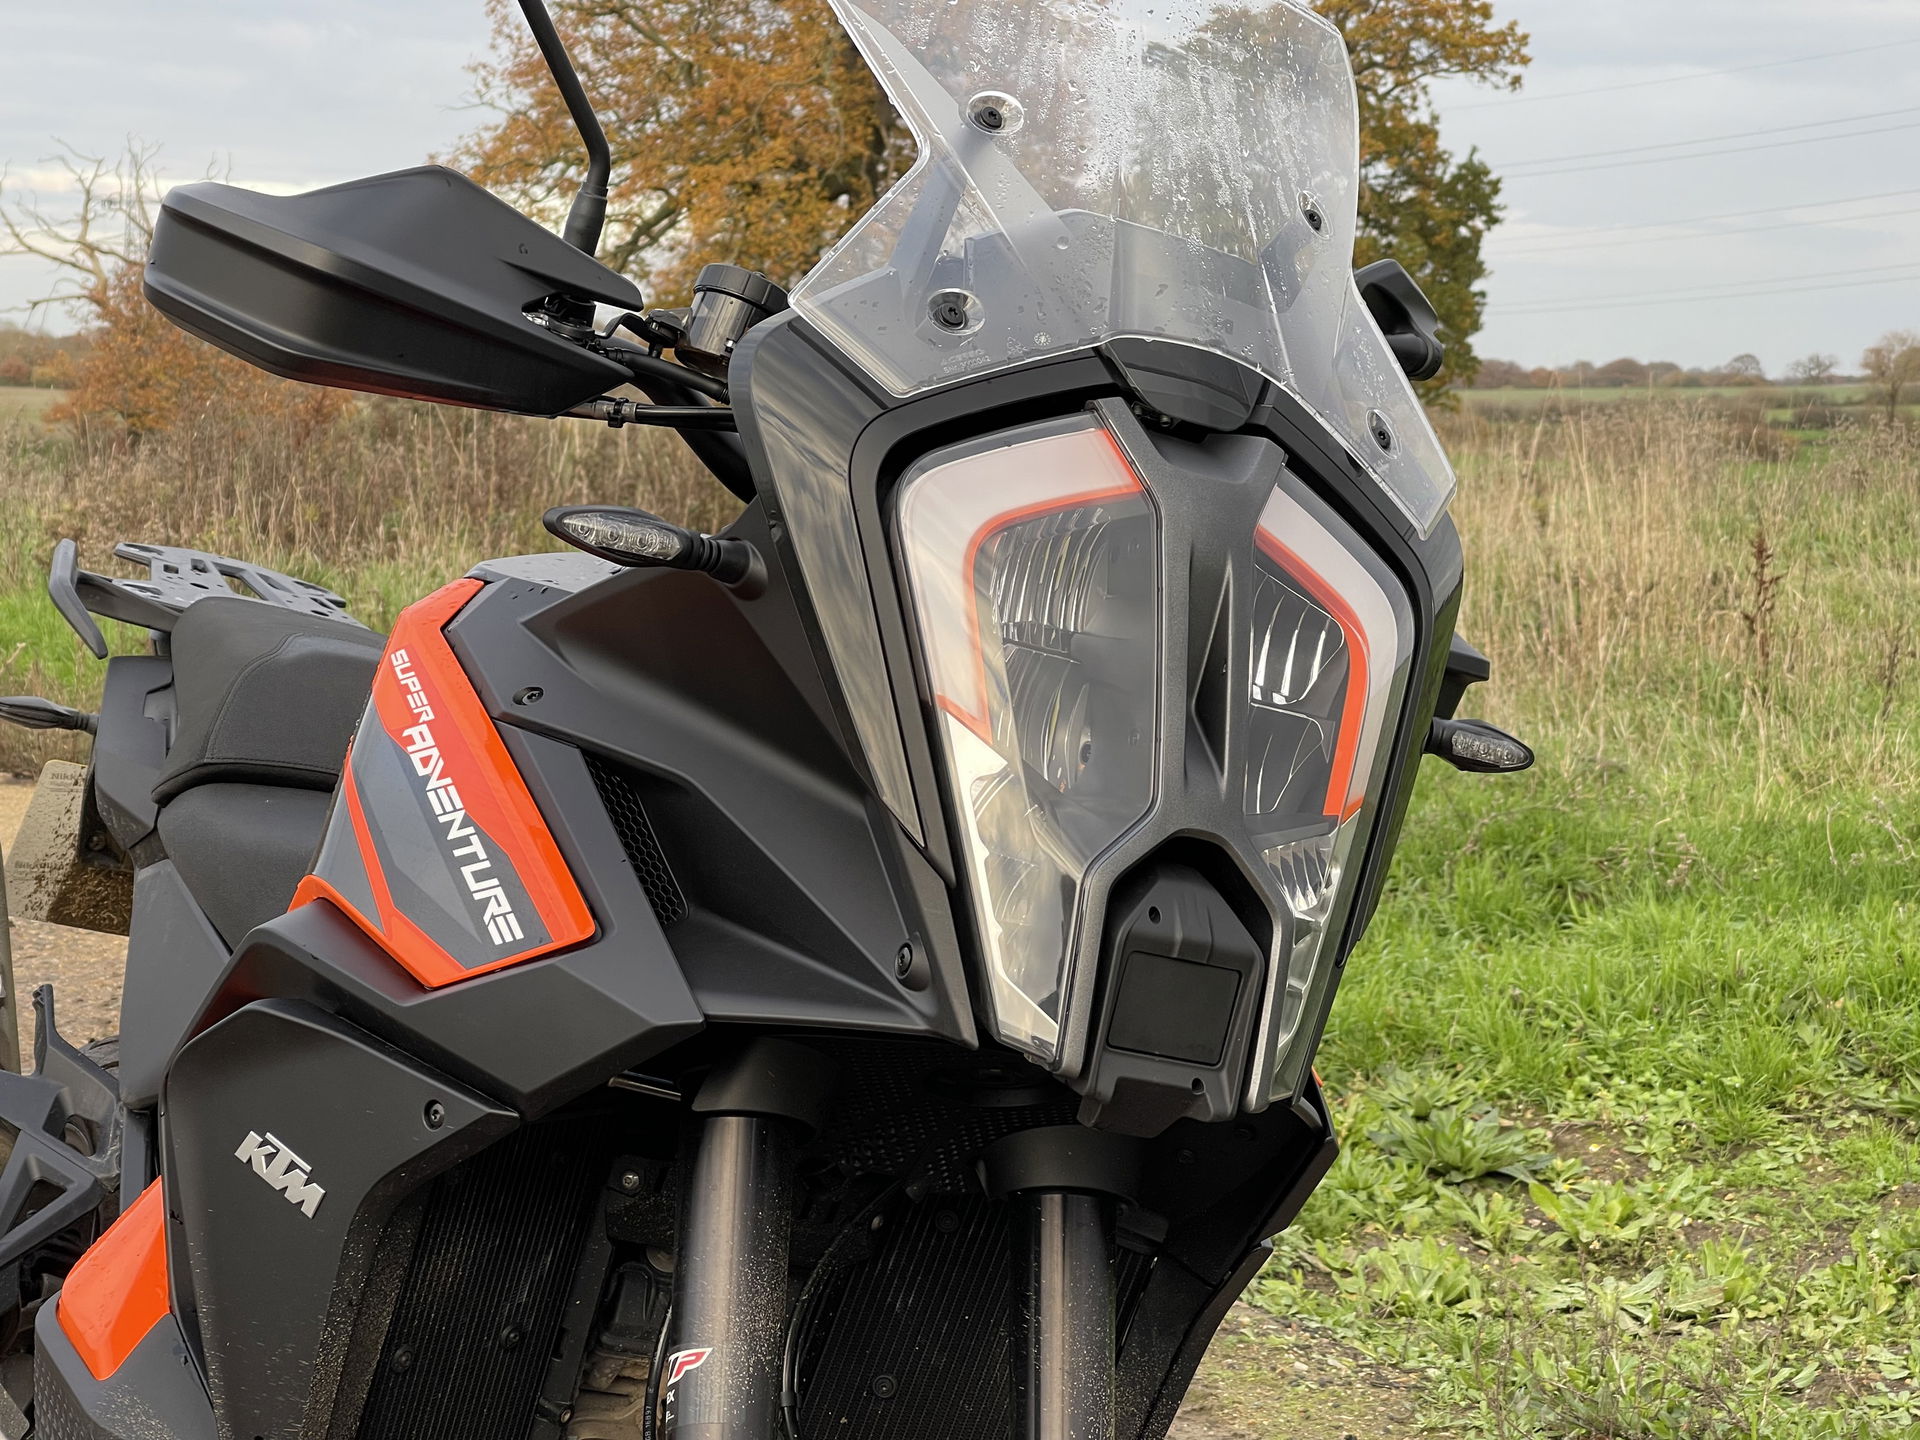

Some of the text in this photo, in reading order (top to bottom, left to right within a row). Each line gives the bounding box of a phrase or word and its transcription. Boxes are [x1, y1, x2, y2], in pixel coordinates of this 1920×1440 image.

[391, 649, 524, 945] SUPER ADVENTURE
[234, 1130, 326, 1219] KTM
